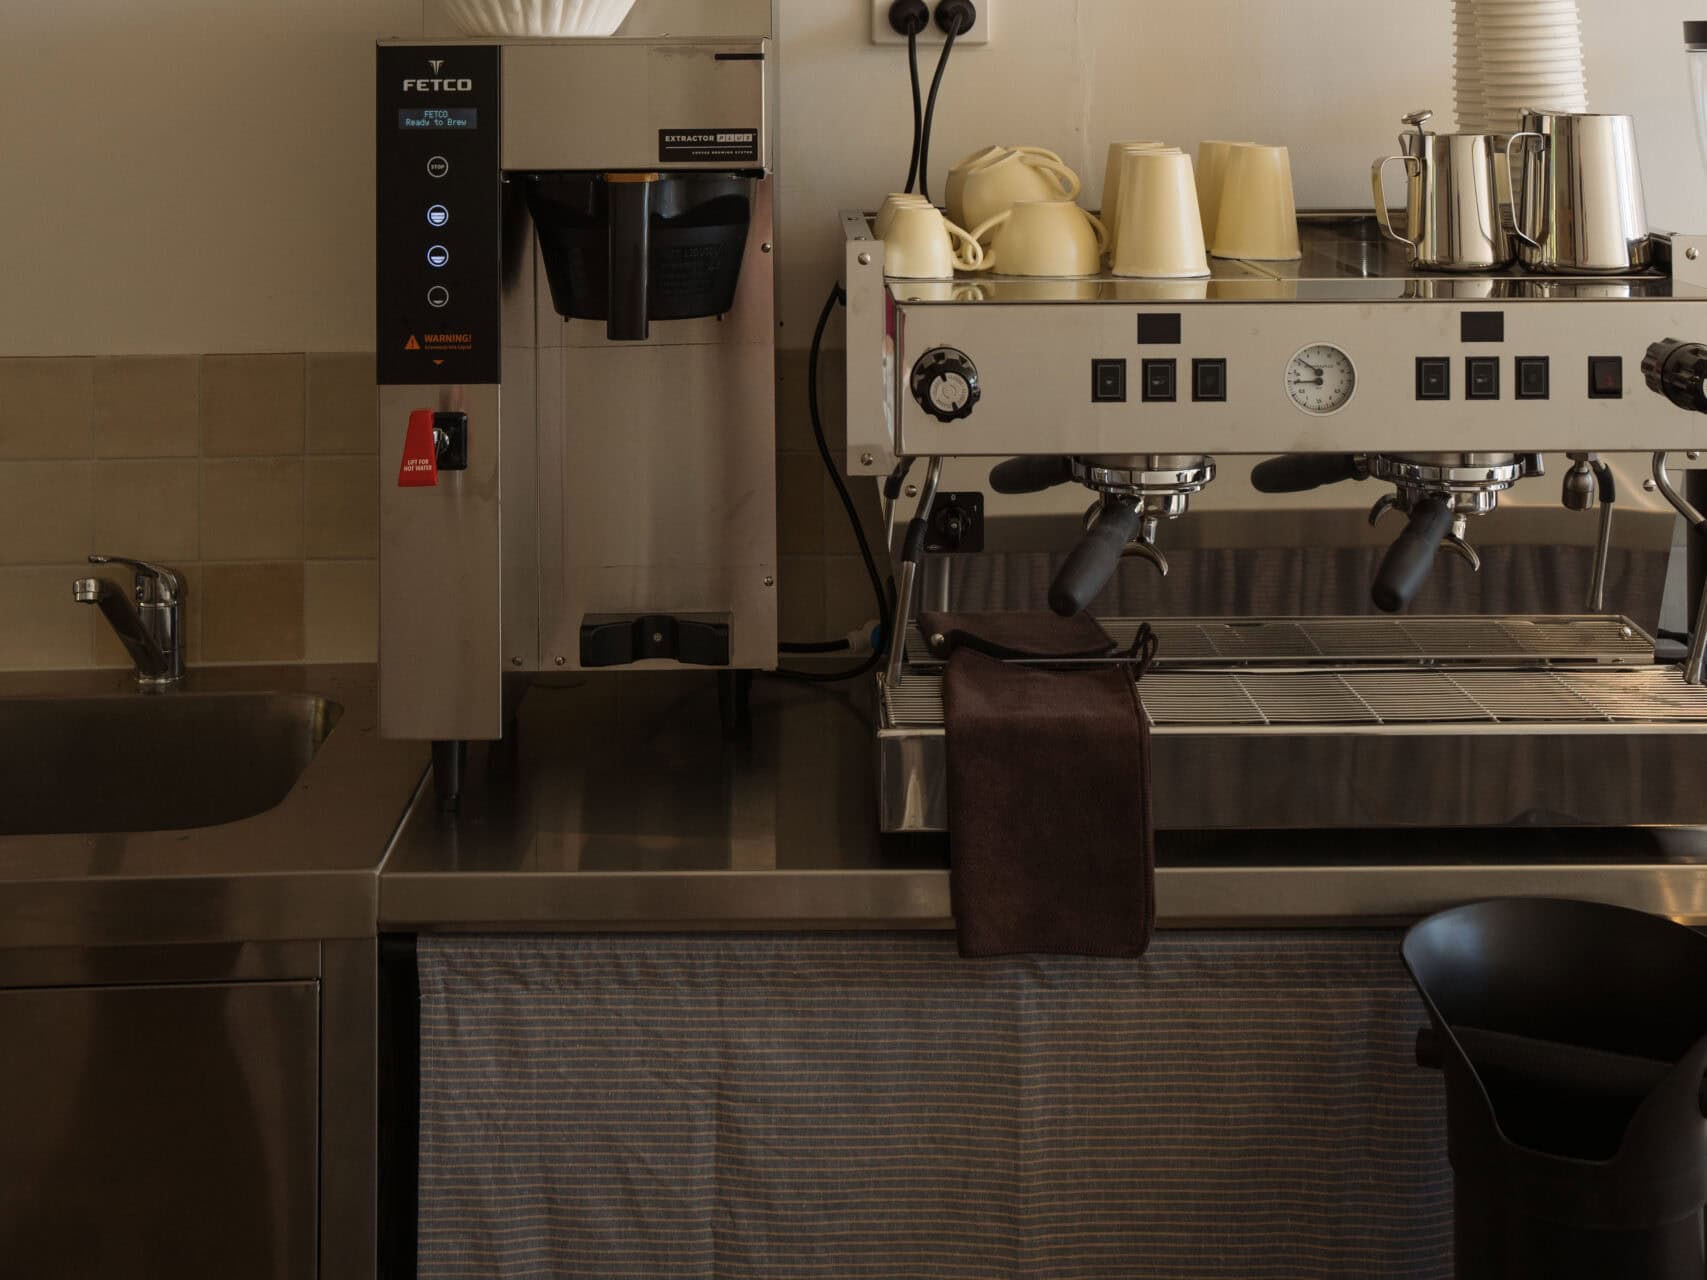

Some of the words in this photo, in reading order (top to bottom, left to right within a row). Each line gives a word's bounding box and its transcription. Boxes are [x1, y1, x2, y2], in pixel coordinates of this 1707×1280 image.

[403, 79, 472, 91] FETCO
[424, 110, 448, 118] FETCO
[406, 118, 430, 126] Ready
[447, 118, 467, 126] Brew
[424, 334, 472, 343] WARNING!
